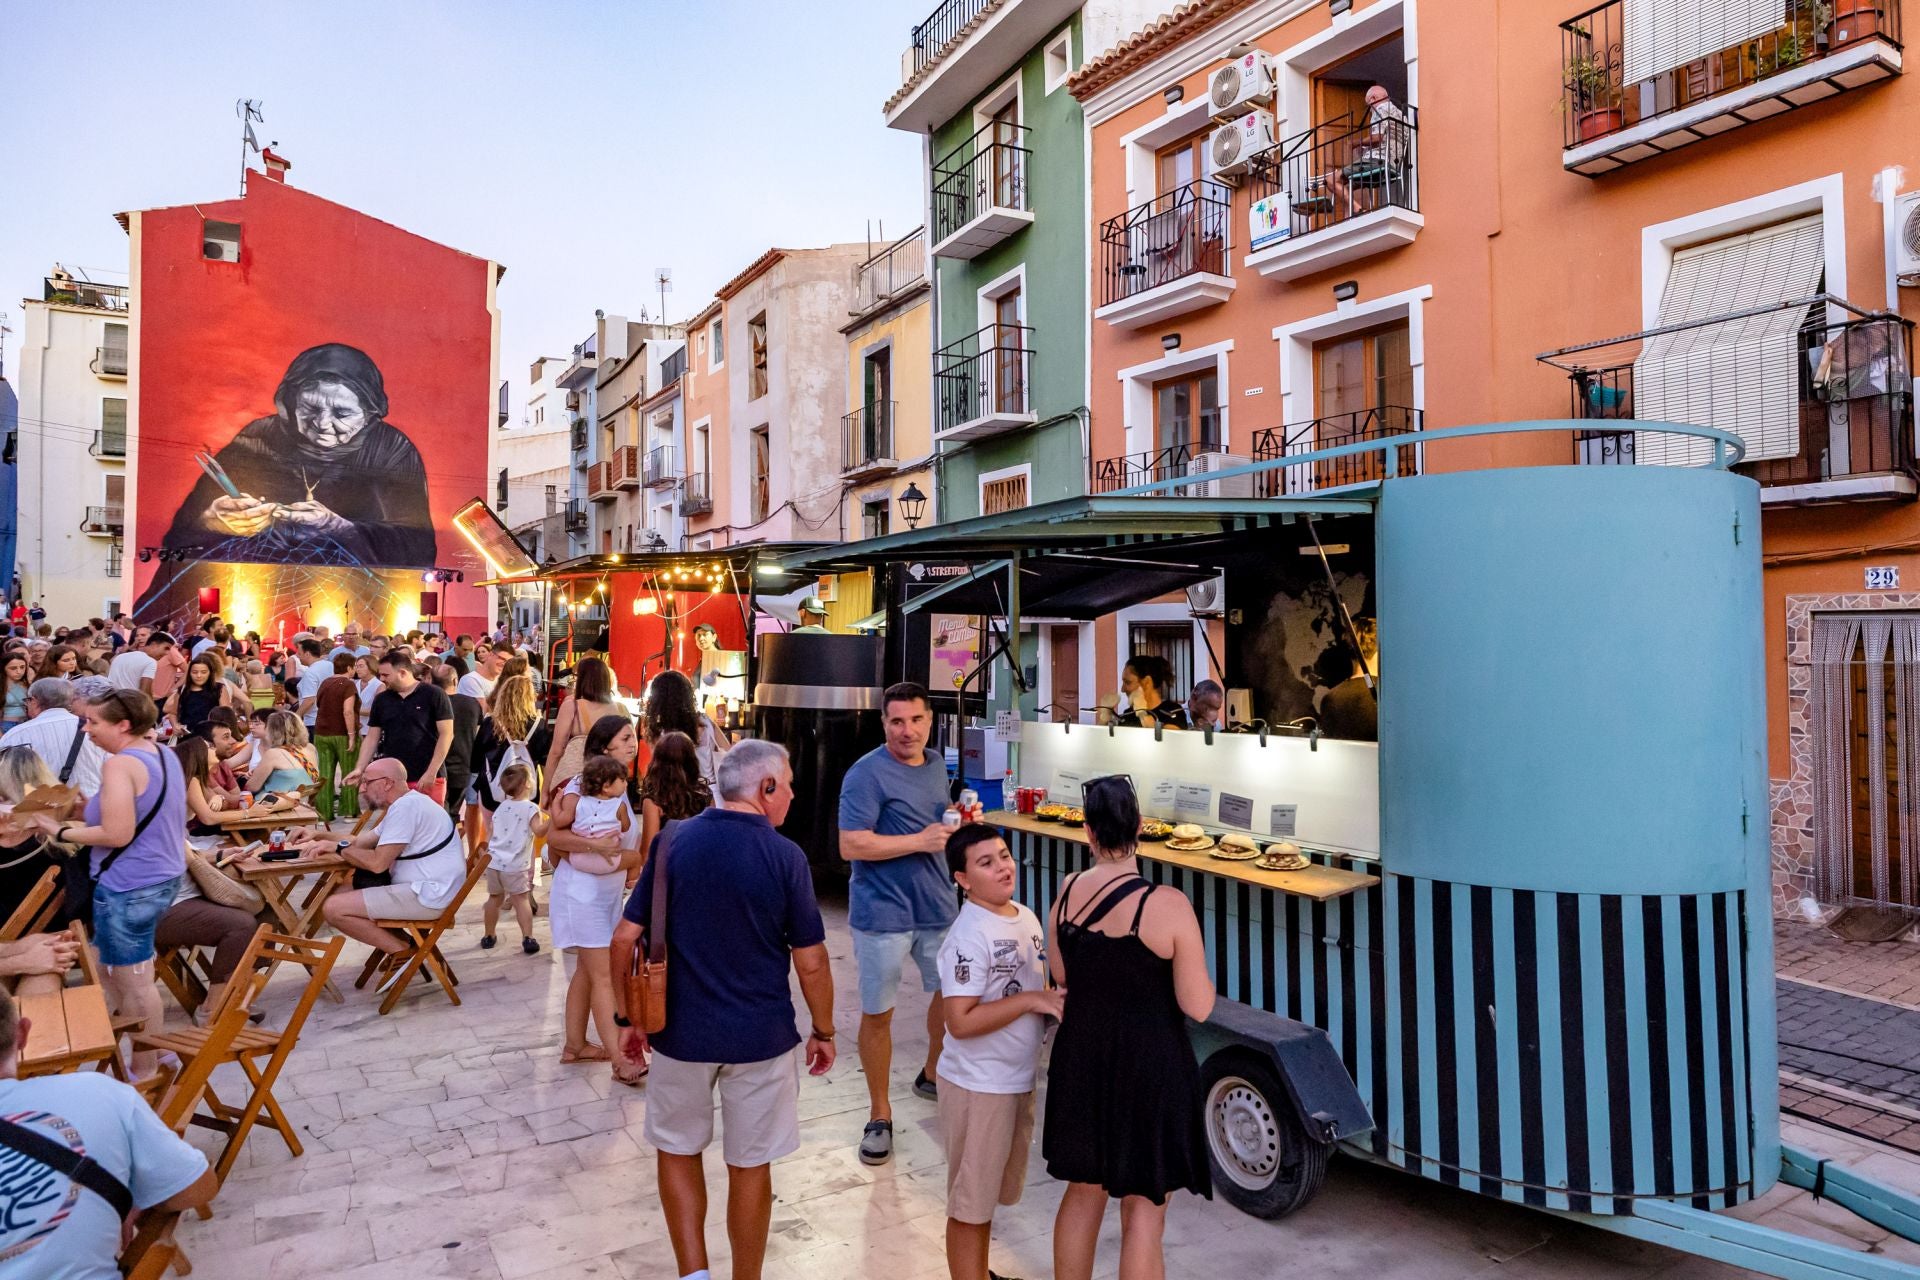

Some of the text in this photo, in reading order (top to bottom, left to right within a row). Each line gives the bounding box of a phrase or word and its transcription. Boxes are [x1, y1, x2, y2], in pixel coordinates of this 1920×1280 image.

[1245, 67, 1254, 77] LG
[1246, 128, 1255, 138] LG
[1870, 571, 1894, 585] 29
